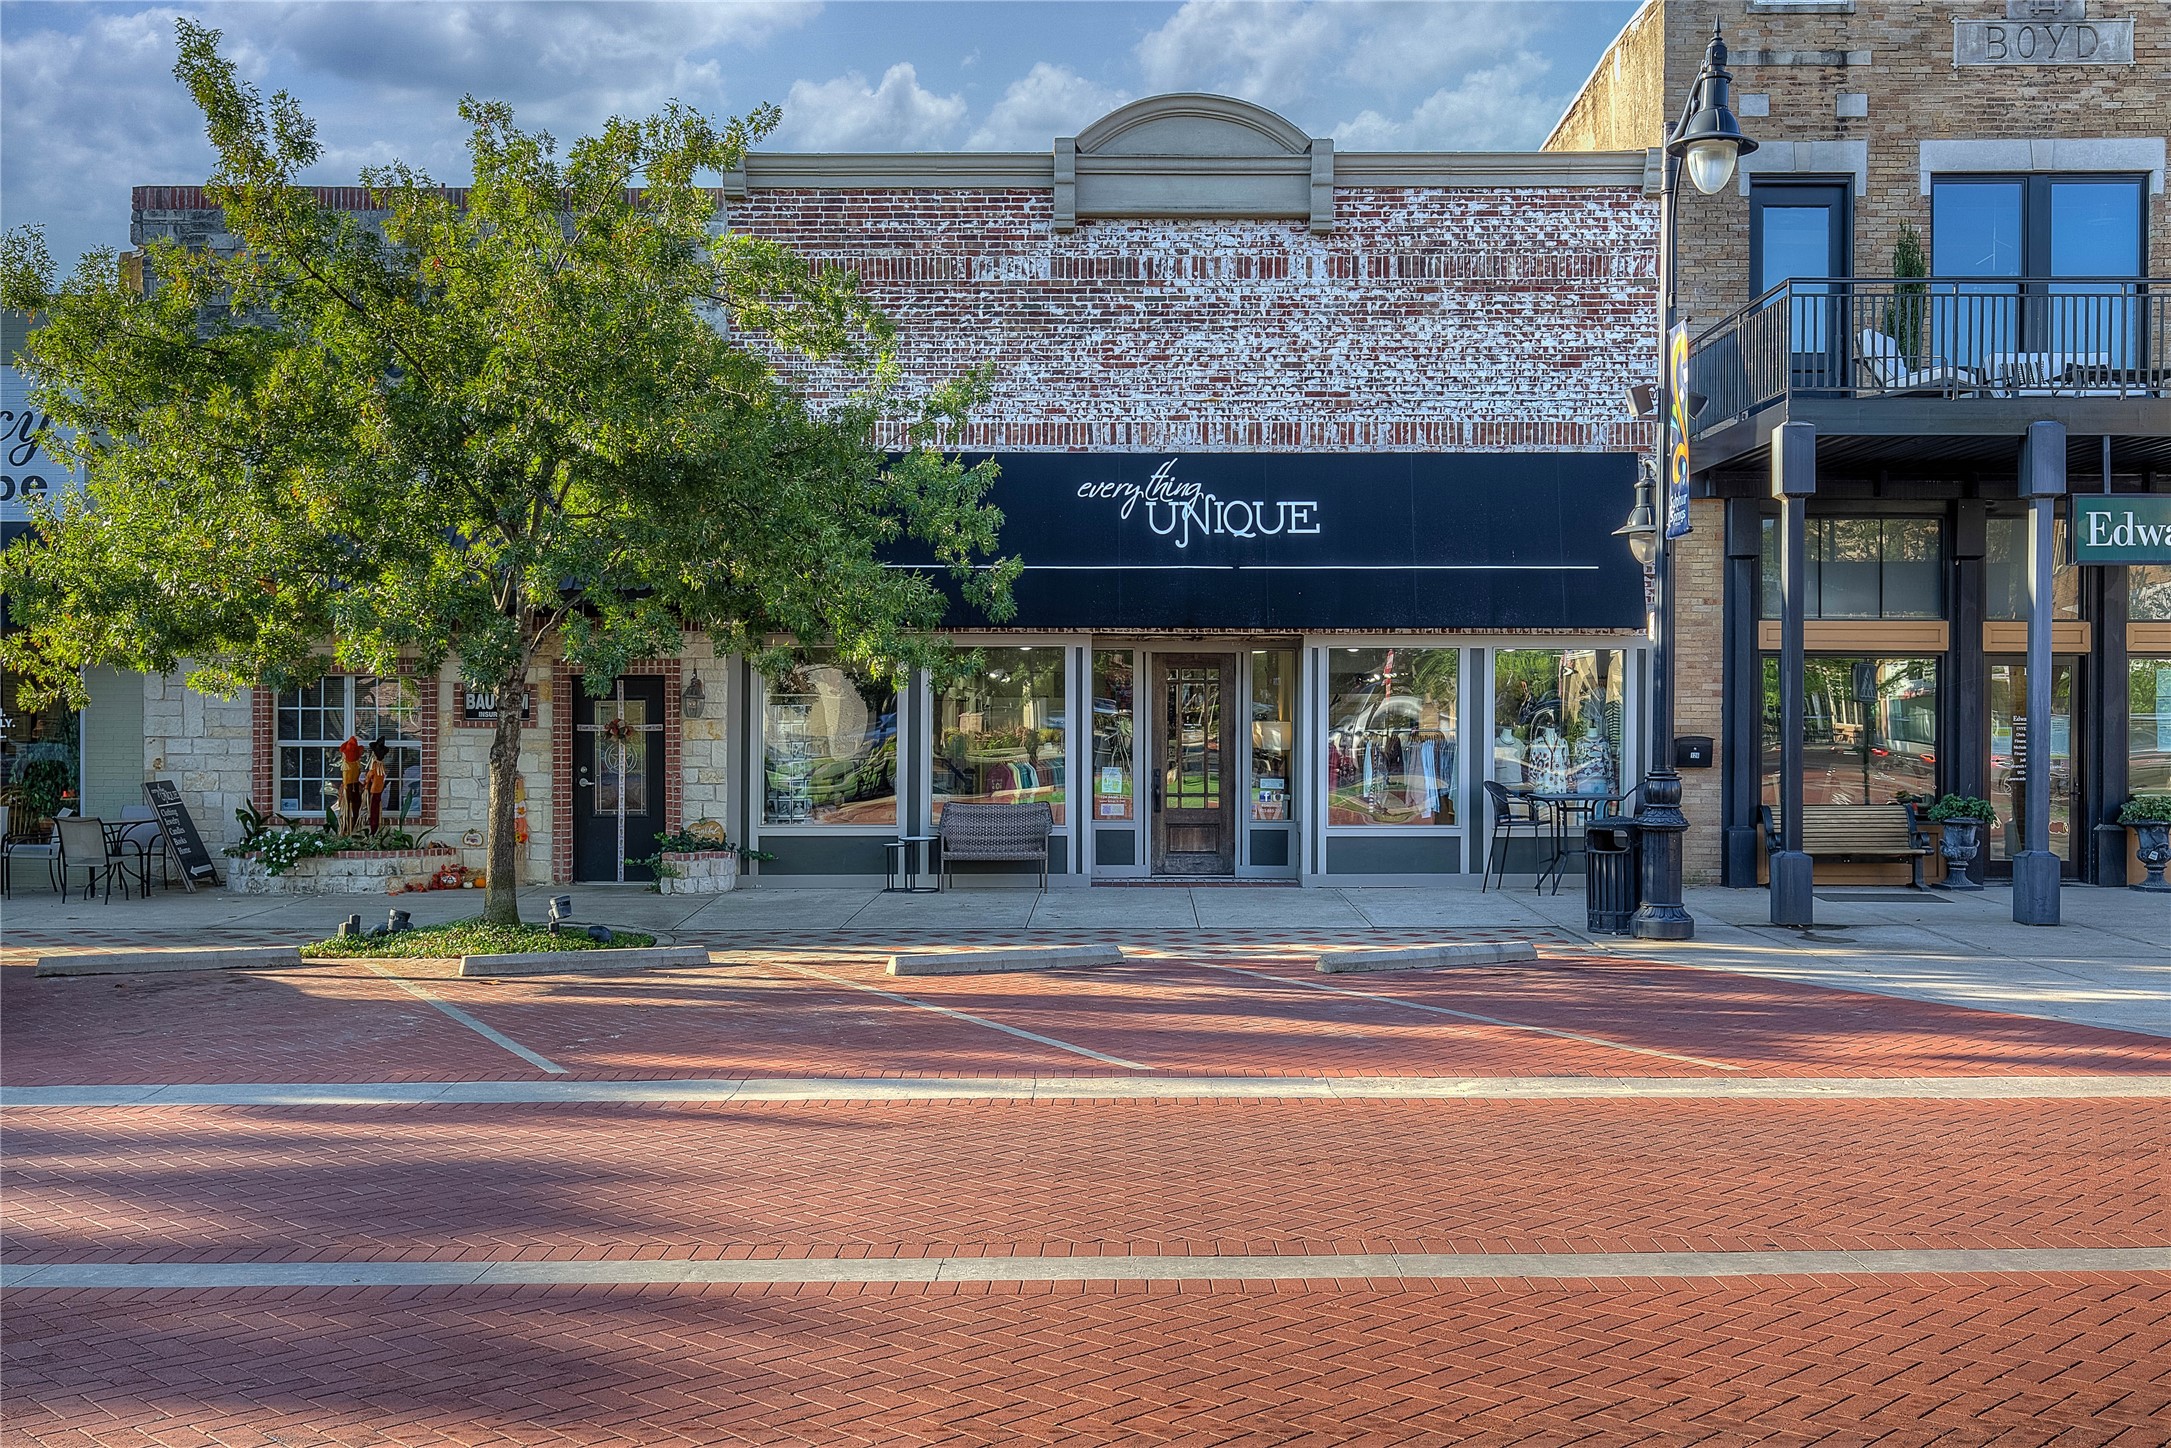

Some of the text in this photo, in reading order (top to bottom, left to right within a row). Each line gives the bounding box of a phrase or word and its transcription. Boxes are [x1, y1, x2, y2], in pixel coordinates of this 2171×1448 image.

[1985, 25, 2099, 60] BOYD
[1077, 457, 1204, 521] everything
[1145, 493, 1321, 549] UNIQUE
[465, 693, 529, 710] BAUM
[160, 808, 179, 817] Clothing
[168, 826, 186, 836] Candles
[173, 836, 188, 846] Books
[177, 847, 192, 855] Home
